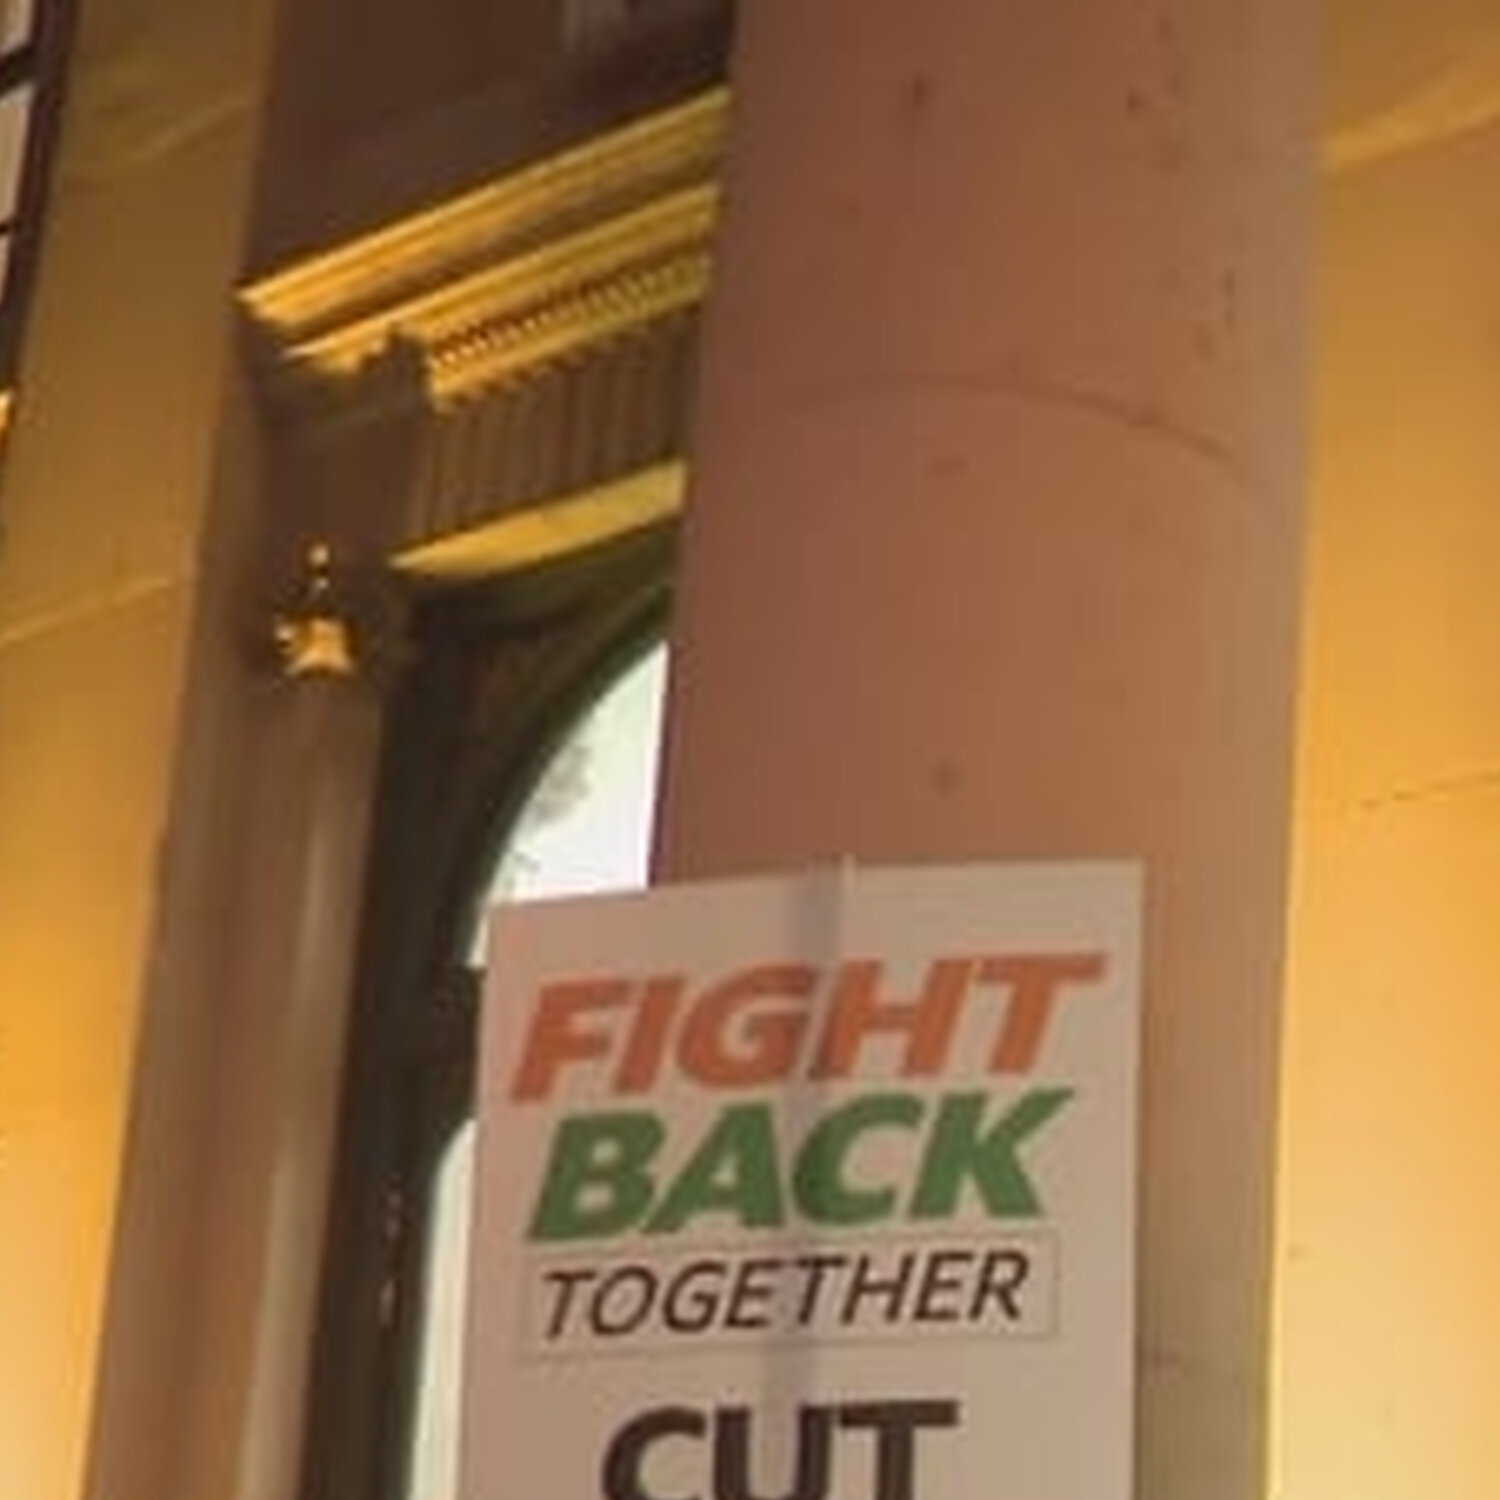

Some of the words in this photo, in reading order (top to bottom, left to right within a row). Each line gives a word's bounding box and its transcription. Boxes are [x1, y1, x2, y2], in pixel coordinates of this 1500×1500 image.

[512, 952, 1110, 1103] FIGHT
[525, 1087, 1075, 1244] BACK
[541, 1249, 1030, 1342] TOGETHER
